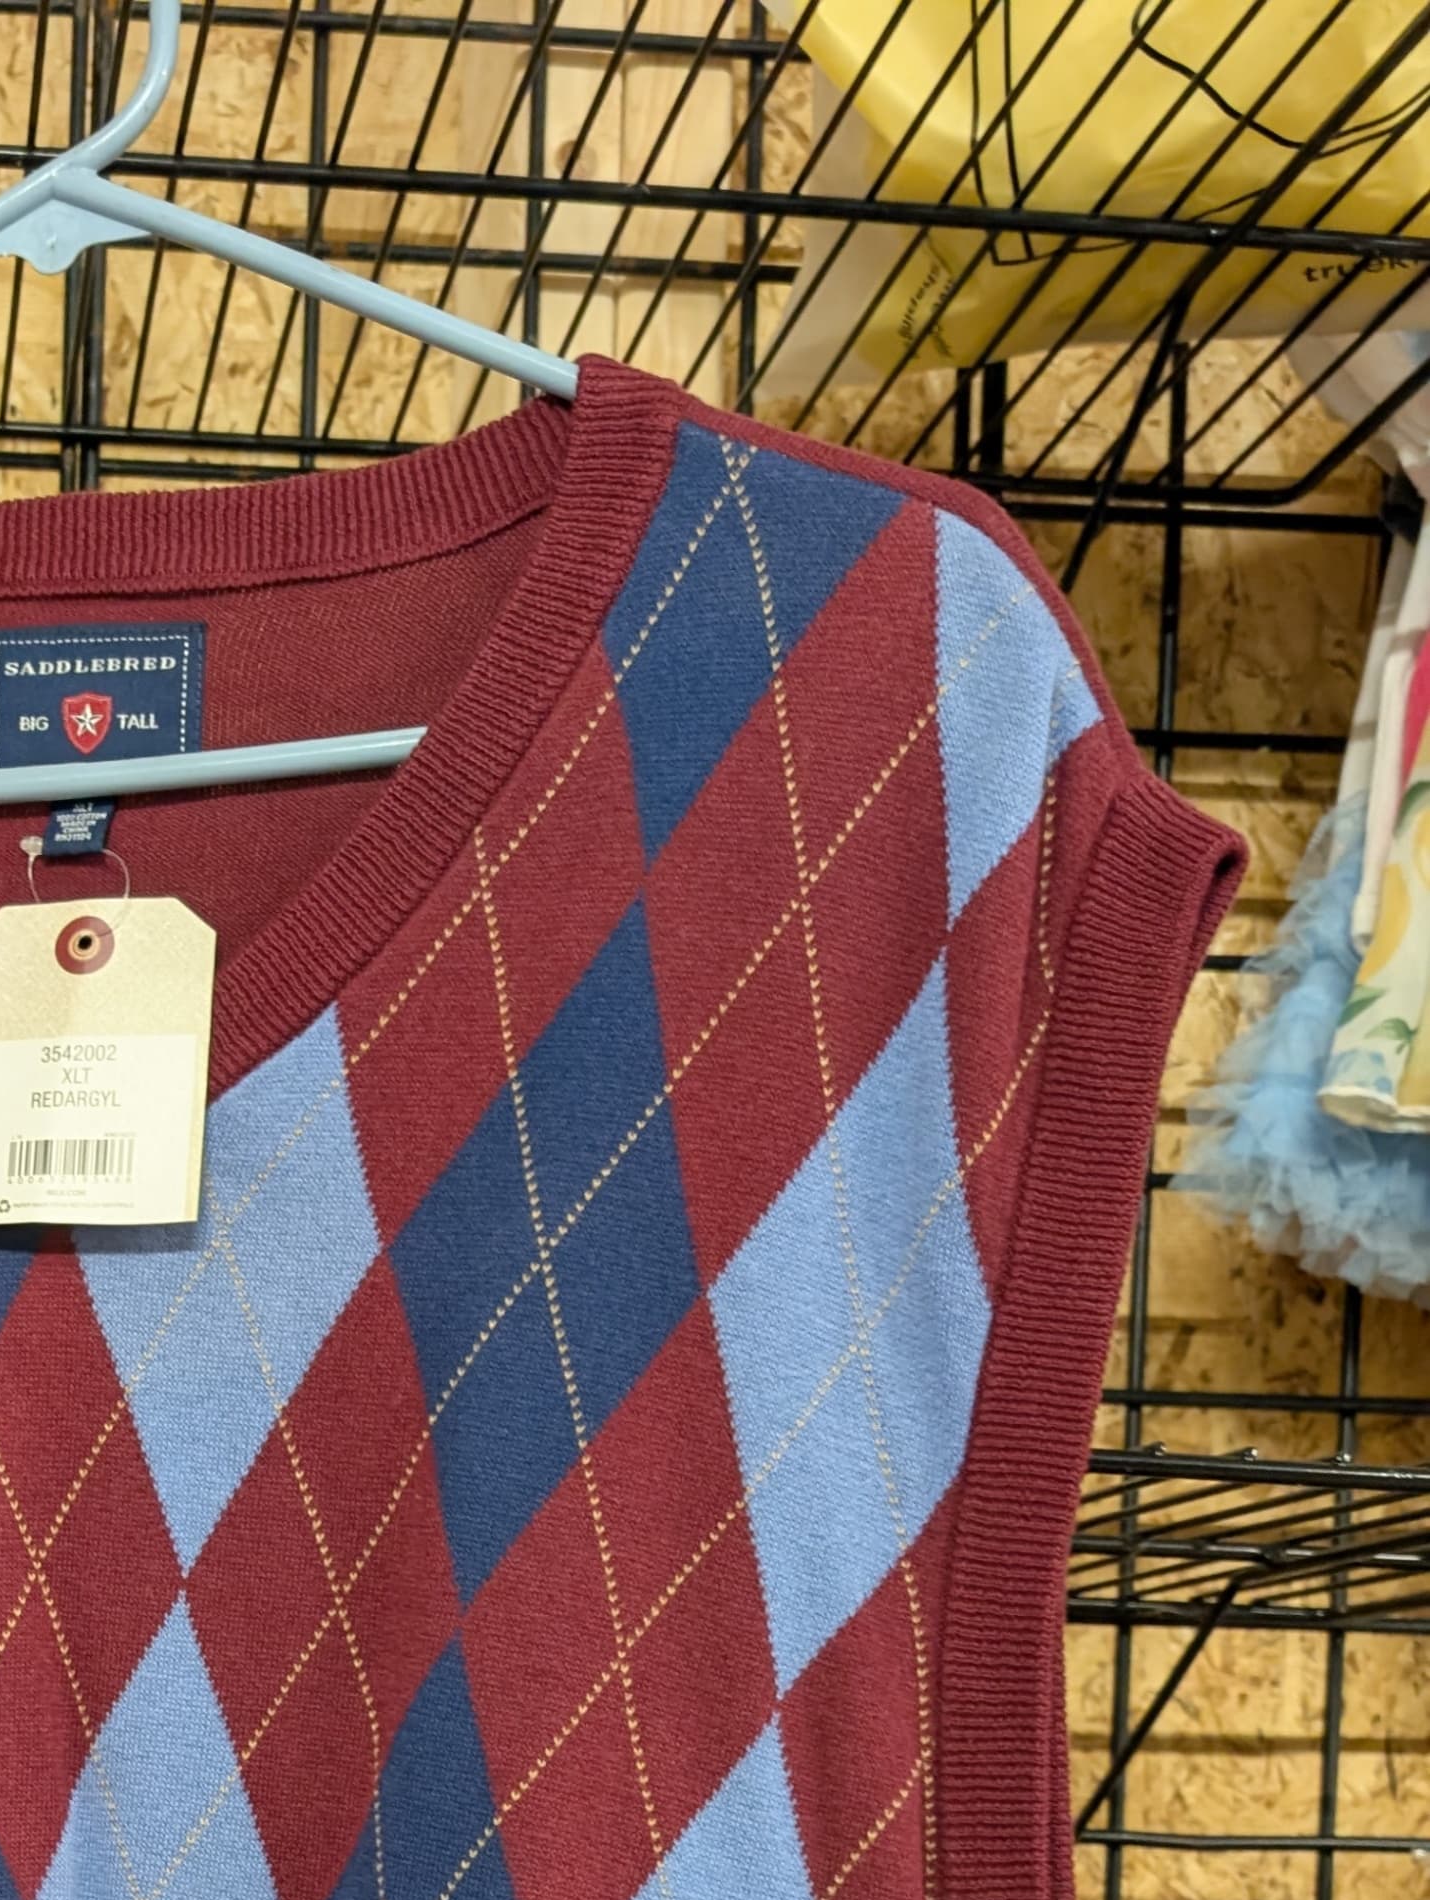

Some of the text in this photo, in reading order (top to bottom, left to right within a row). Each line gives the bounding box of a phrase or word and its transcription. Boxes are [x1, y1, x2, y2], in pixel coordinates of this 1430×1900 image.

[4, 656, 176, 677] SADDLEBRED
[19, 713, 158, 732] BIG TALL
[40, 1044, 117, 1063] 3542002
[61, 1067, 92, 1085] XLT
[31, 1089, 121, 1109] REDARGYL
